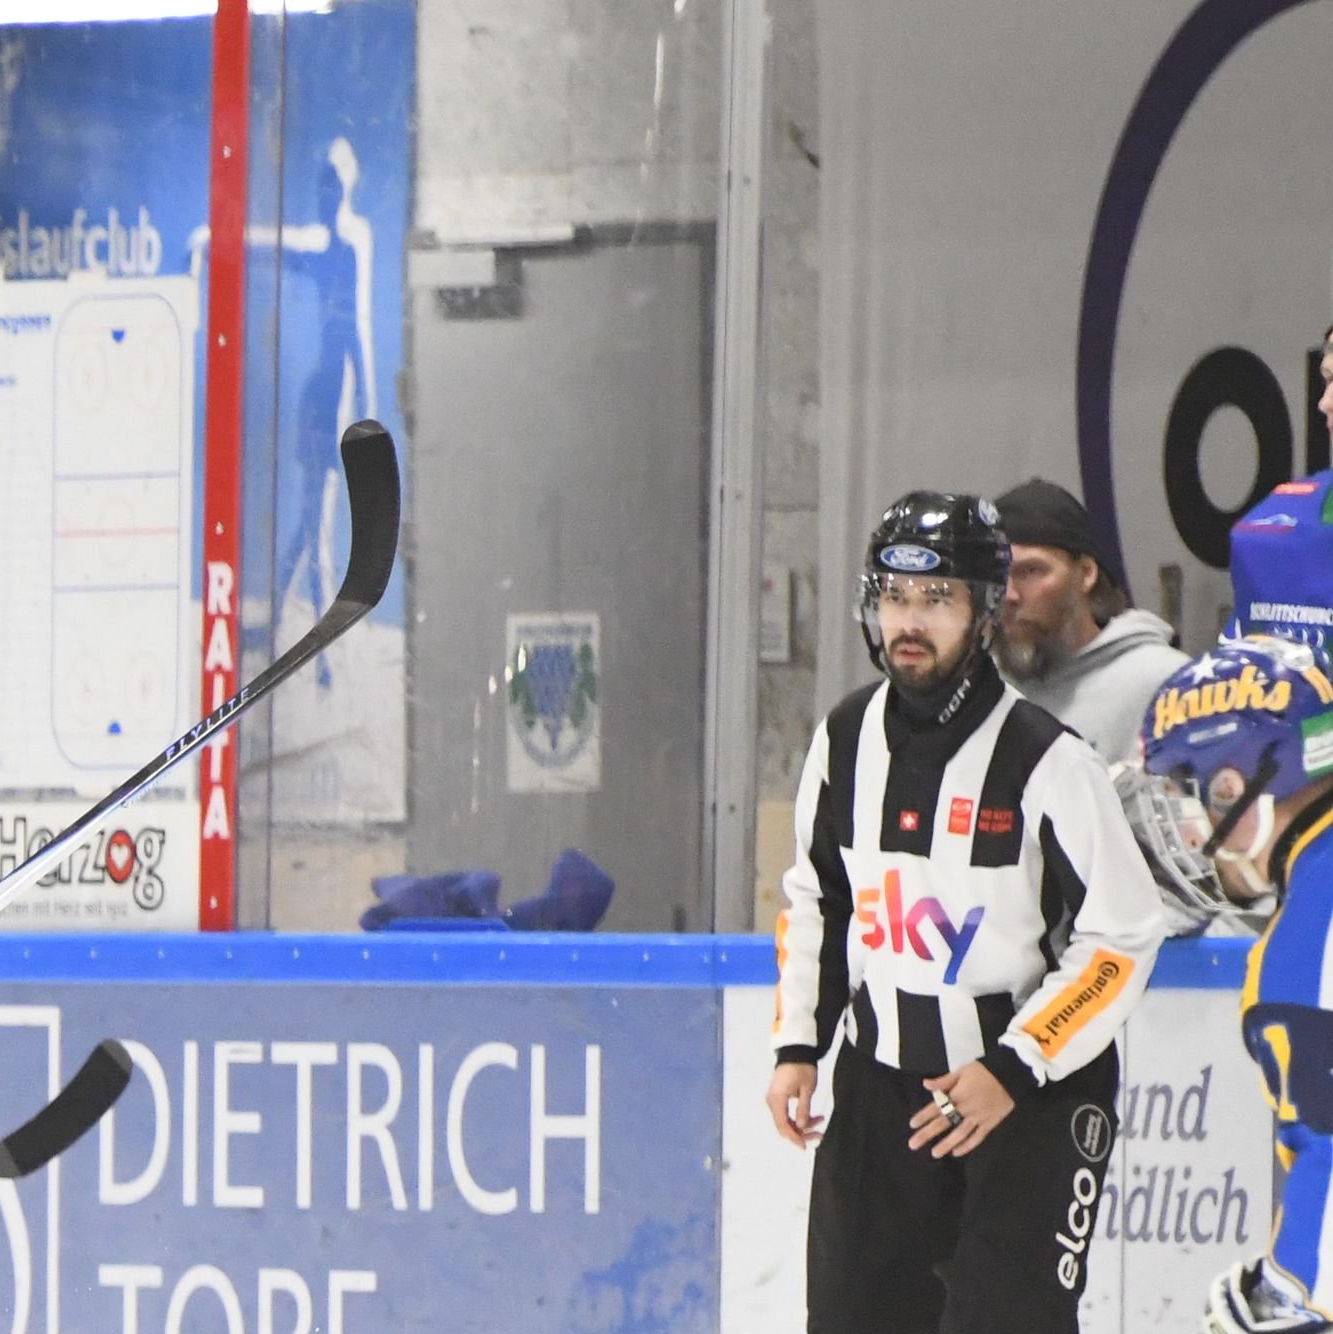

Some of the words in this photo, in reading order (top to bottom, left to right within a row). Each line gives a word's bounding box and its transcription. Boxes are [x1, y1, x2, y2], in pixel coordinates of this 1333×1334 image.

[164, 687, 250, 761] FLYLITE
[1153, 666, 1292, 739] Hawks
[856, 868, 986, 986] sky
[1044, 959, 1120, 1038] Continental
[98, 1040, 602, 1214] DIETRICH
[1057, 1166, 1098, 1290] elco
[1100, 1165, 1250, 1245] ndlich
